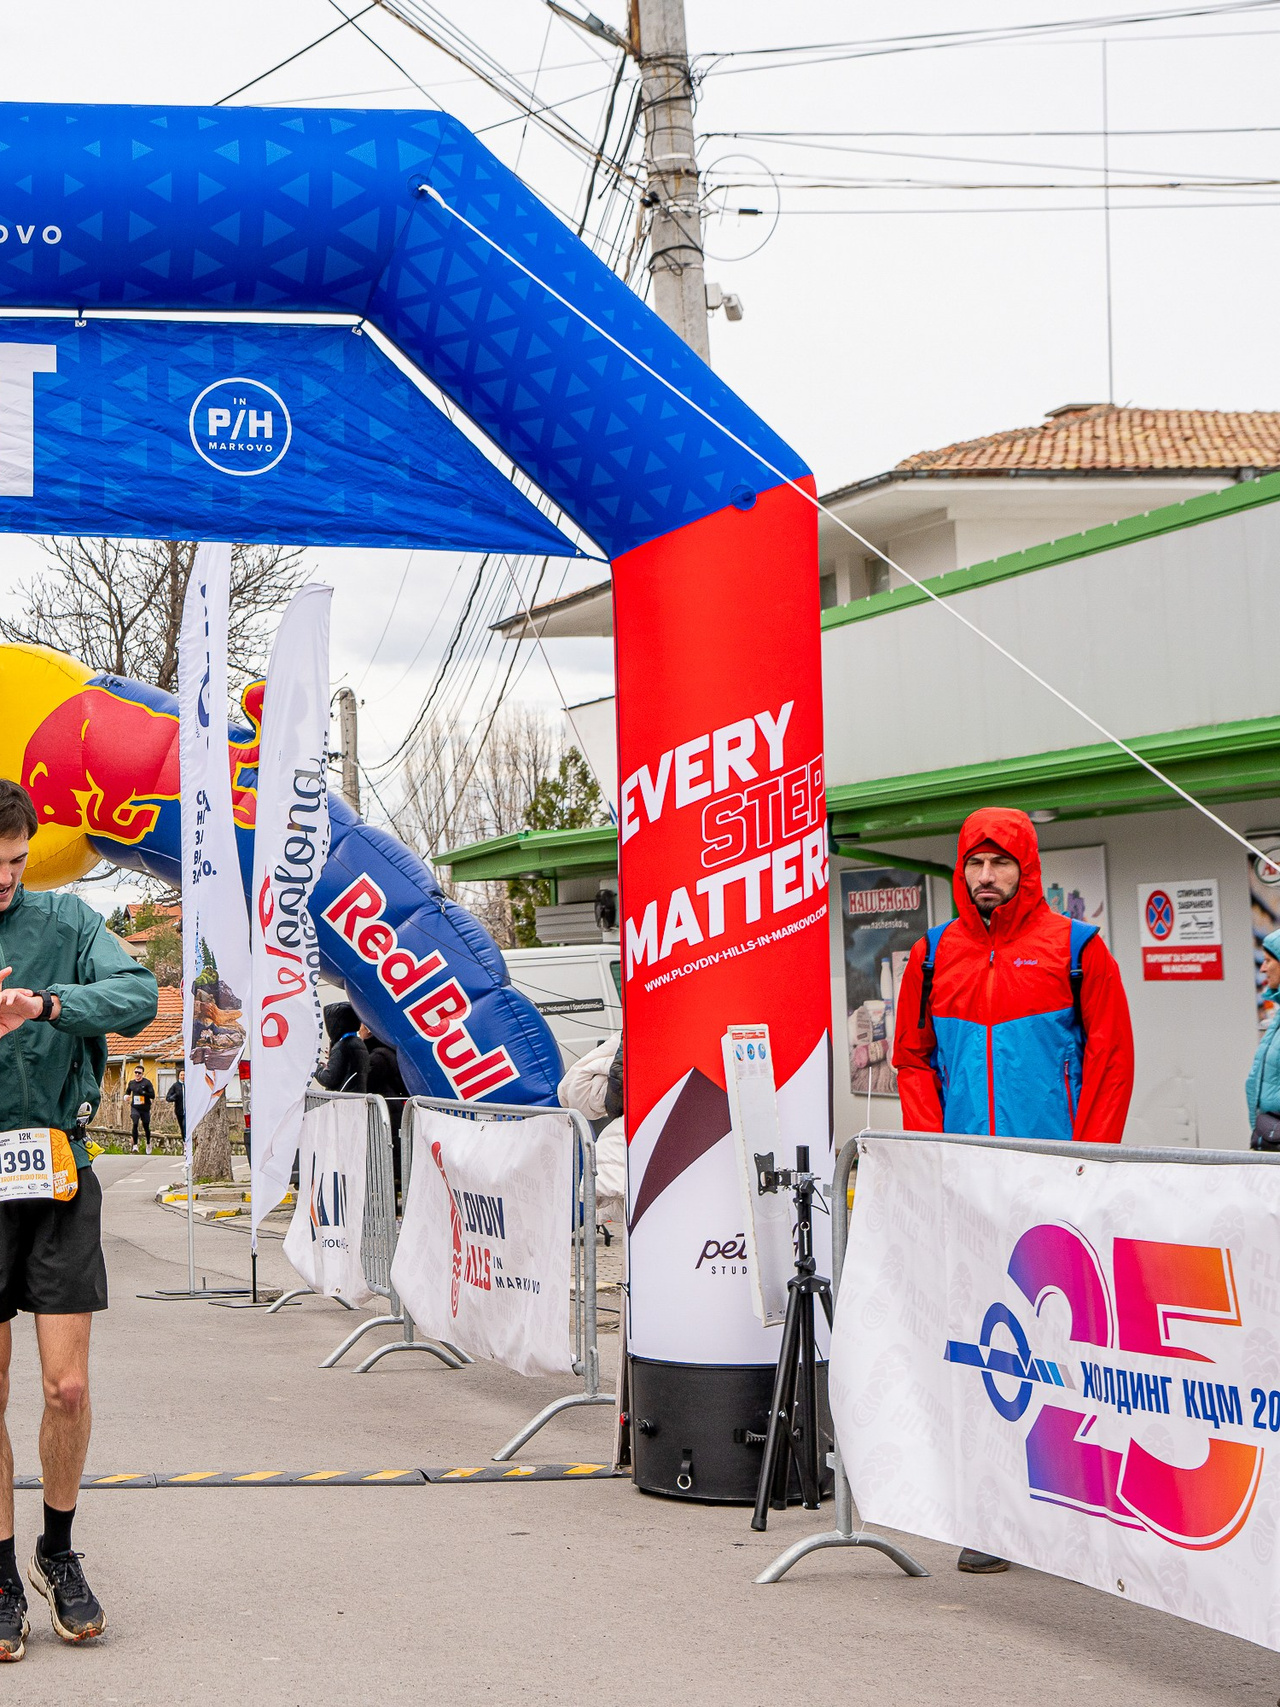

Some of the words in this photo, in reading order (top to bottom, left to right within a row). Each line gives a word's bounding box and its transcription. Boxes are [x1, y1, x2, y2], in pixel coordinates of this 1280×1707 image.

[233, 397, 247, 406] IN
[208, 441, 273, 453] MARKOVO
[621, 700, 794, 846] EVERY
[701, 753, 826, 868] STEP
[848, 886, 920, 915] НАШЕНСКО
[645, 904, 826, 992] WWW.PLOVDIV-HILLS-IN-MARKOVO.COM
[323, 875, 445, 1000] Red
[406, 980, 517, 1100] Bull
[711, 1266, 748, 1275] STUD
[1080, 1360, 1172, 1415] ХОЛДИНГ
[1182, 1378, 1243, 1429] КЦМ
